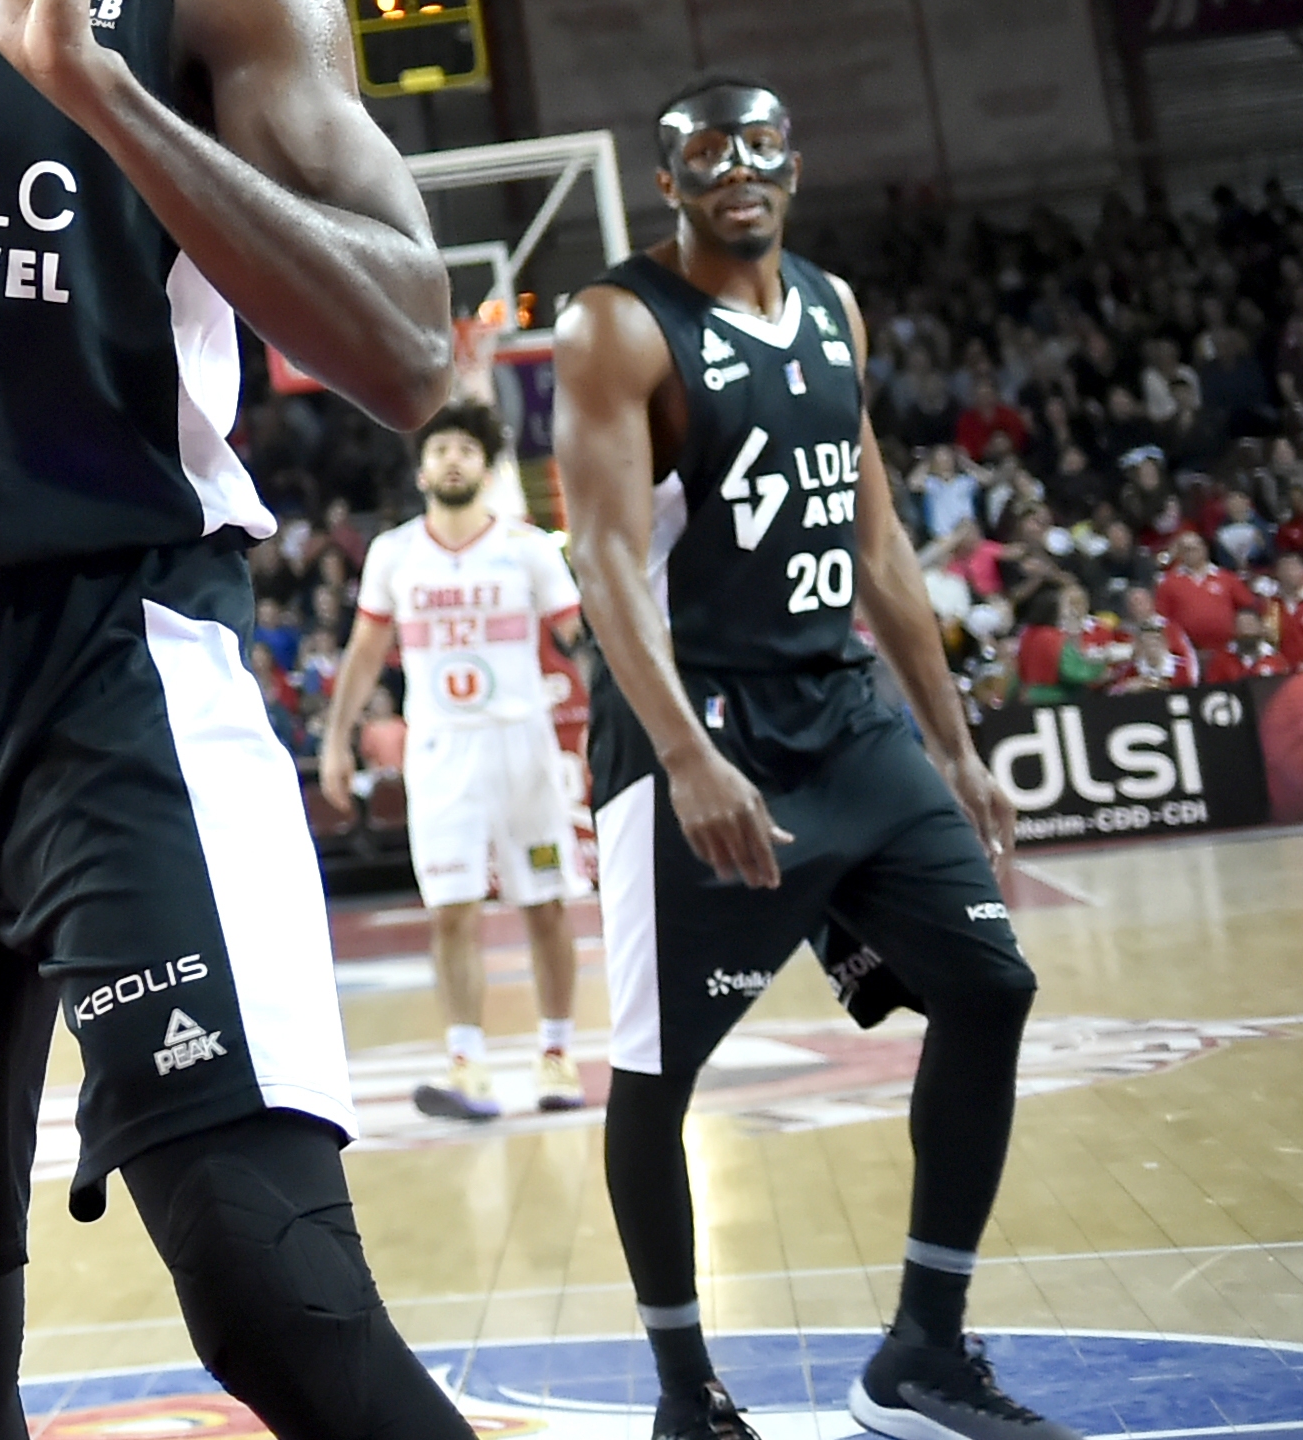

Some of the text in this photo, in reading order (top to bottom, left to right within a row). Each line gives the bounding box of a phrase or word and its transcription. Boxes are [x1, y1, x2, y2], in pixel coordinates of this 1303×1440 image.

[786, 548, 853, 615] 20
[438, 615, 477, 650] 32
[446, 671, 478, 702] U
[990, 693, 1204, 812] dlsi
[153, 1030, 228, 1076] PEAK
